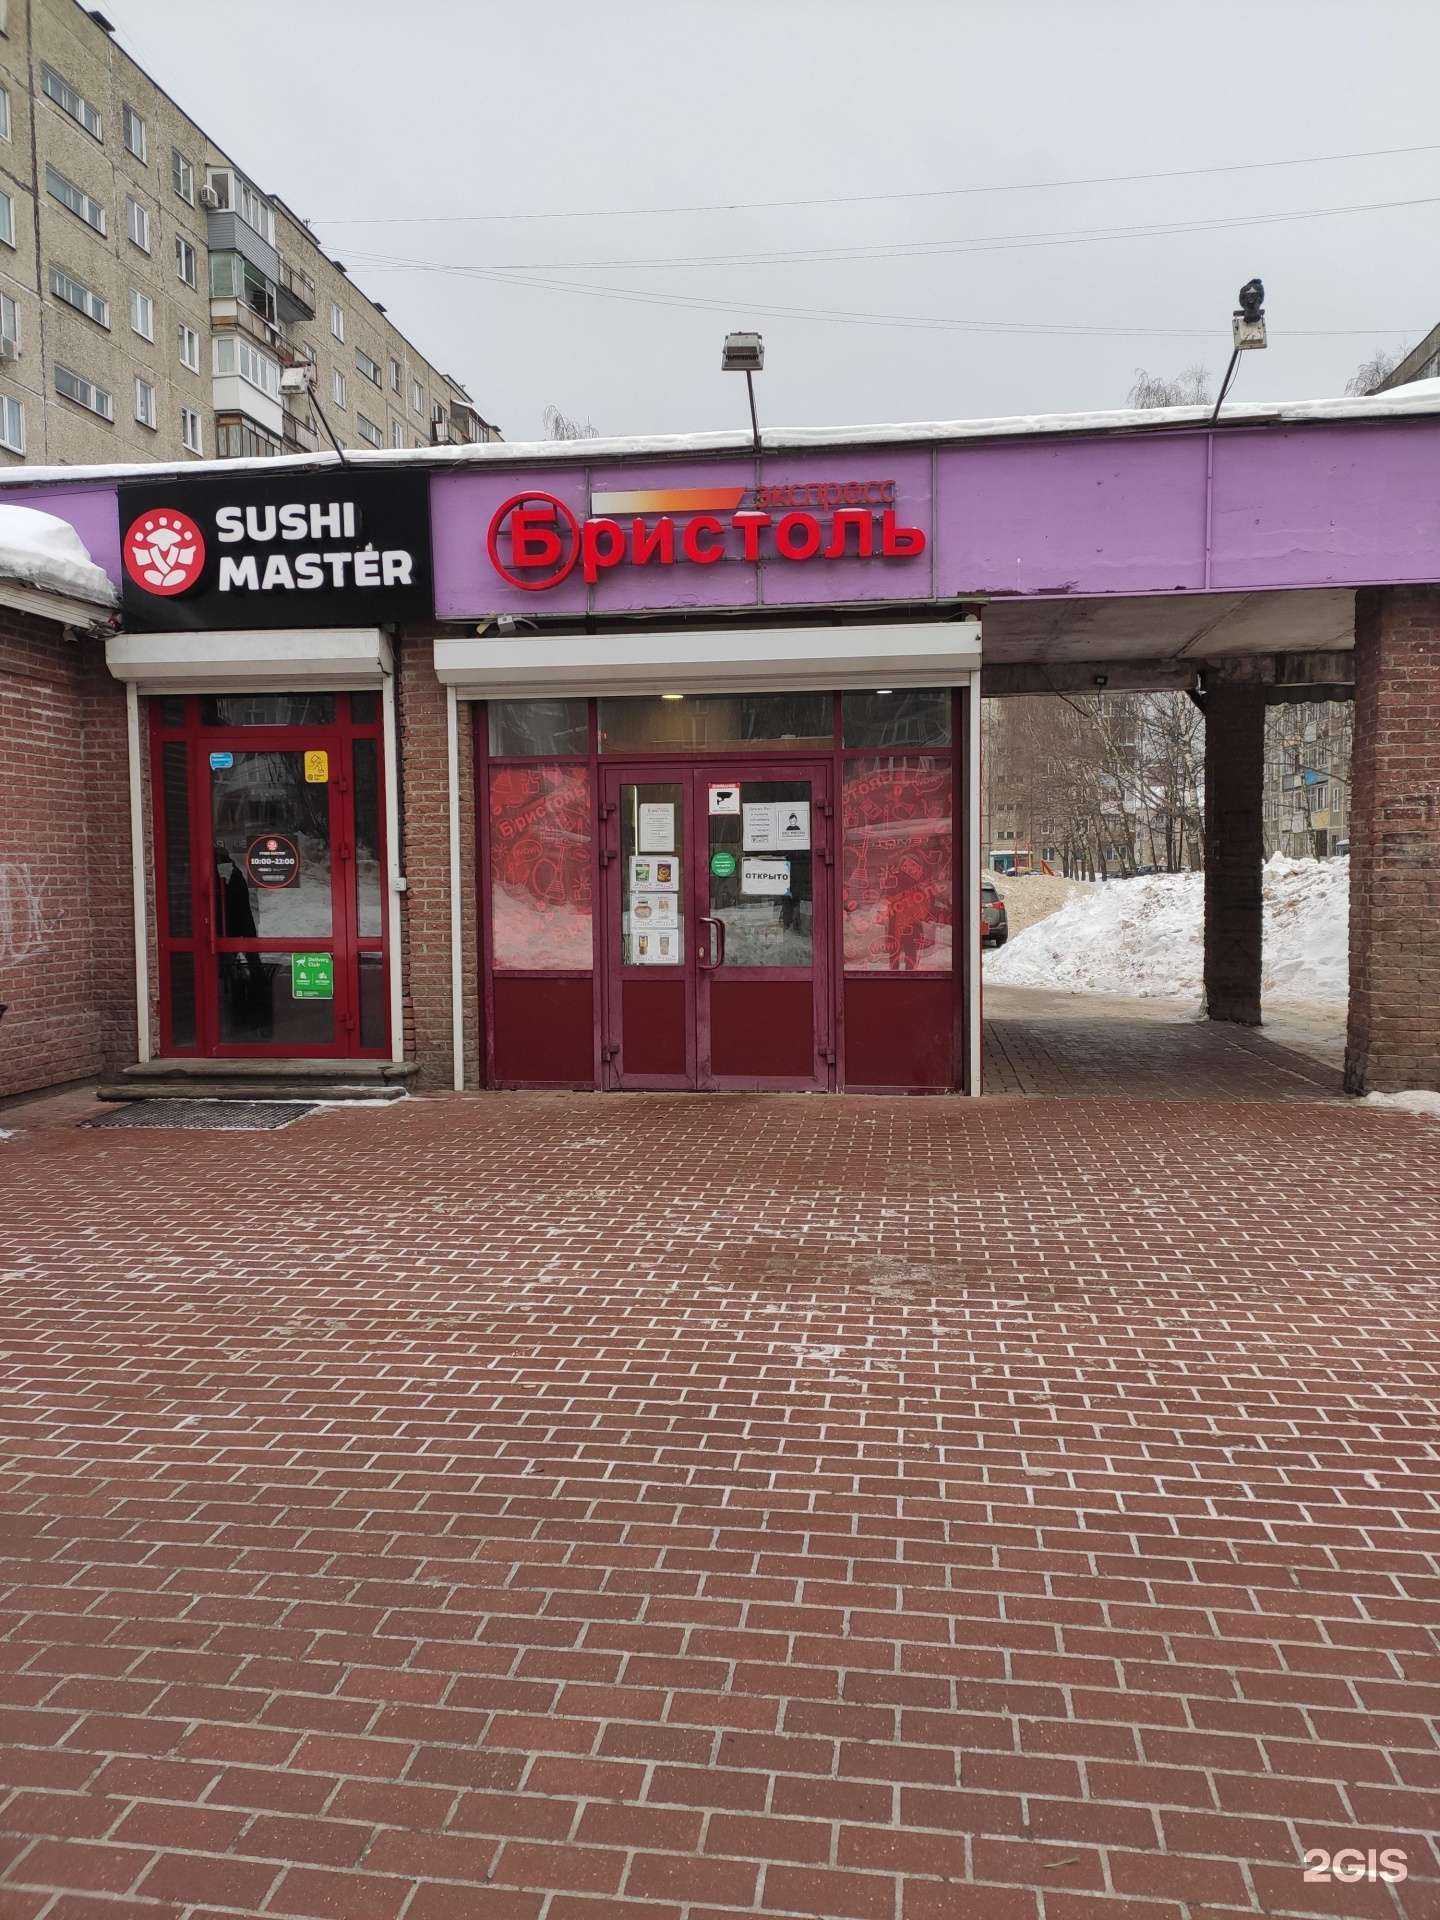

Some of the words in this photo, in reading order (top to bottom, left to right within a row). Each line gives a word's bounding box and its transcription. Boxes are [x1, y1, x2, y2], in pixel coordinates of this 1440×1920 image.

[755, 480, 897, 511] экспресс
[215, 502, 355, 542] SUSHI
[488, 497, 927, 587] Бристоль
[745, 872, 789, 881] ОТКРЫТО
